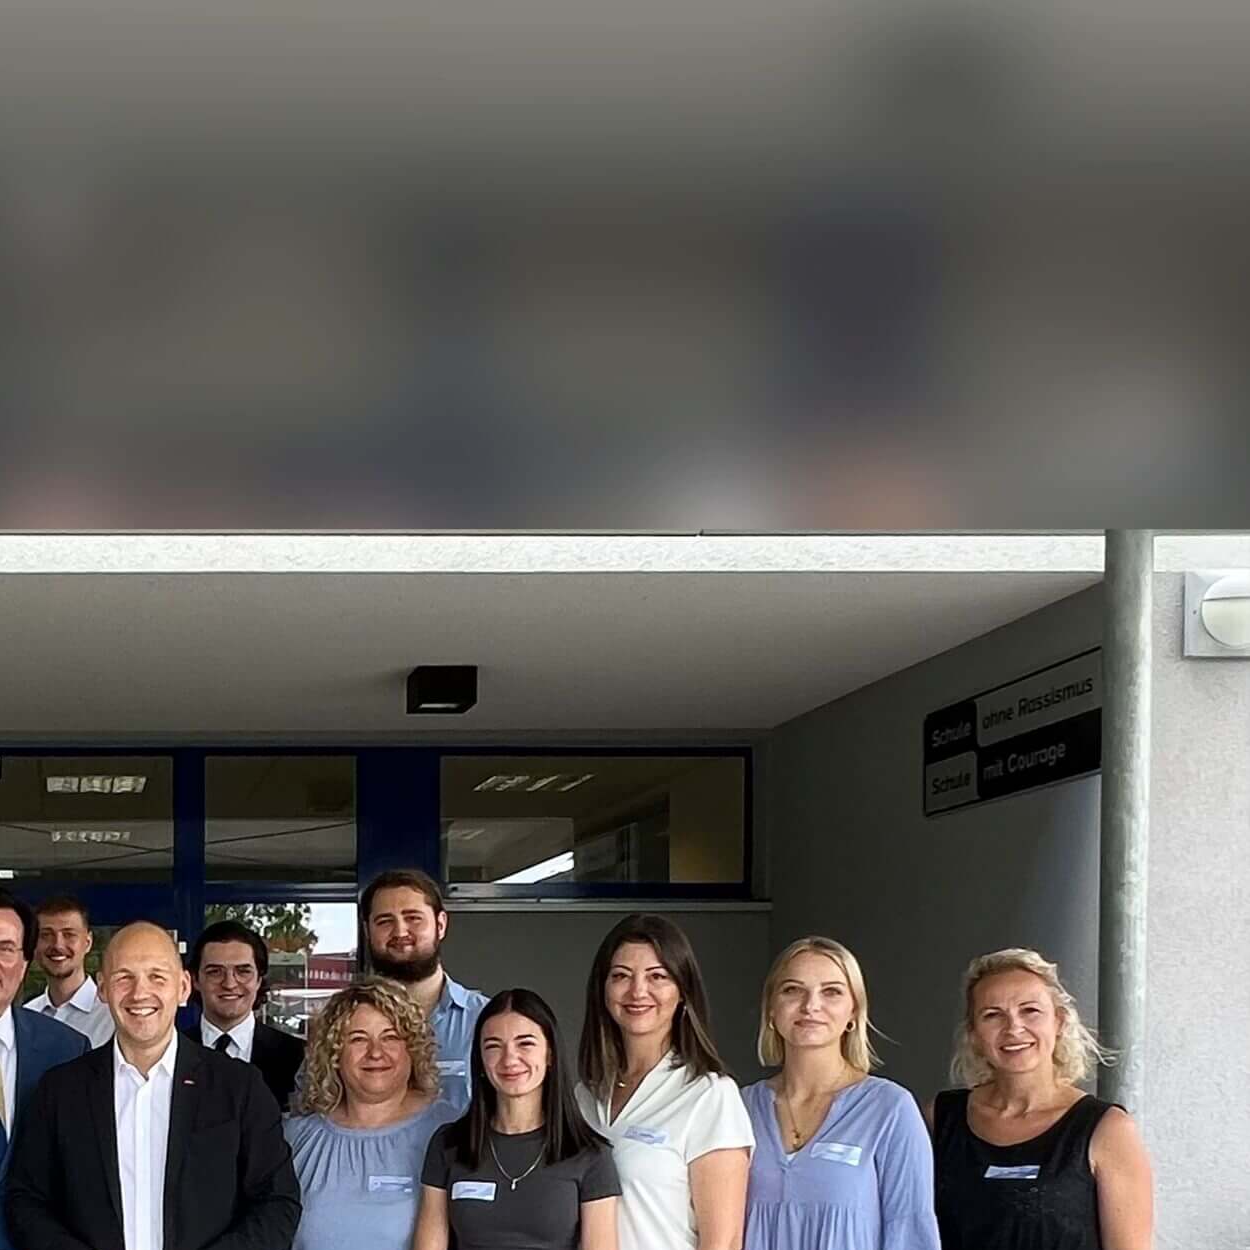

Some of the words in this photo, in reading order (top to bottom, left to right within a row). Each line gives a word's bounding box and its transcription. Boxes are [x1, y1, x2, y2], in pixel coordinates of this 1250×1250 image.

[931, 720, 973, 748] Schule
[982, 706, 1014, 730] ohne
[1017, 677, 1094, 718] Rassismus
[931, 770, 972, 796] Schule
[983, 759, 1004, 782] mit
[1007, 742, 1067, 774] Courage
